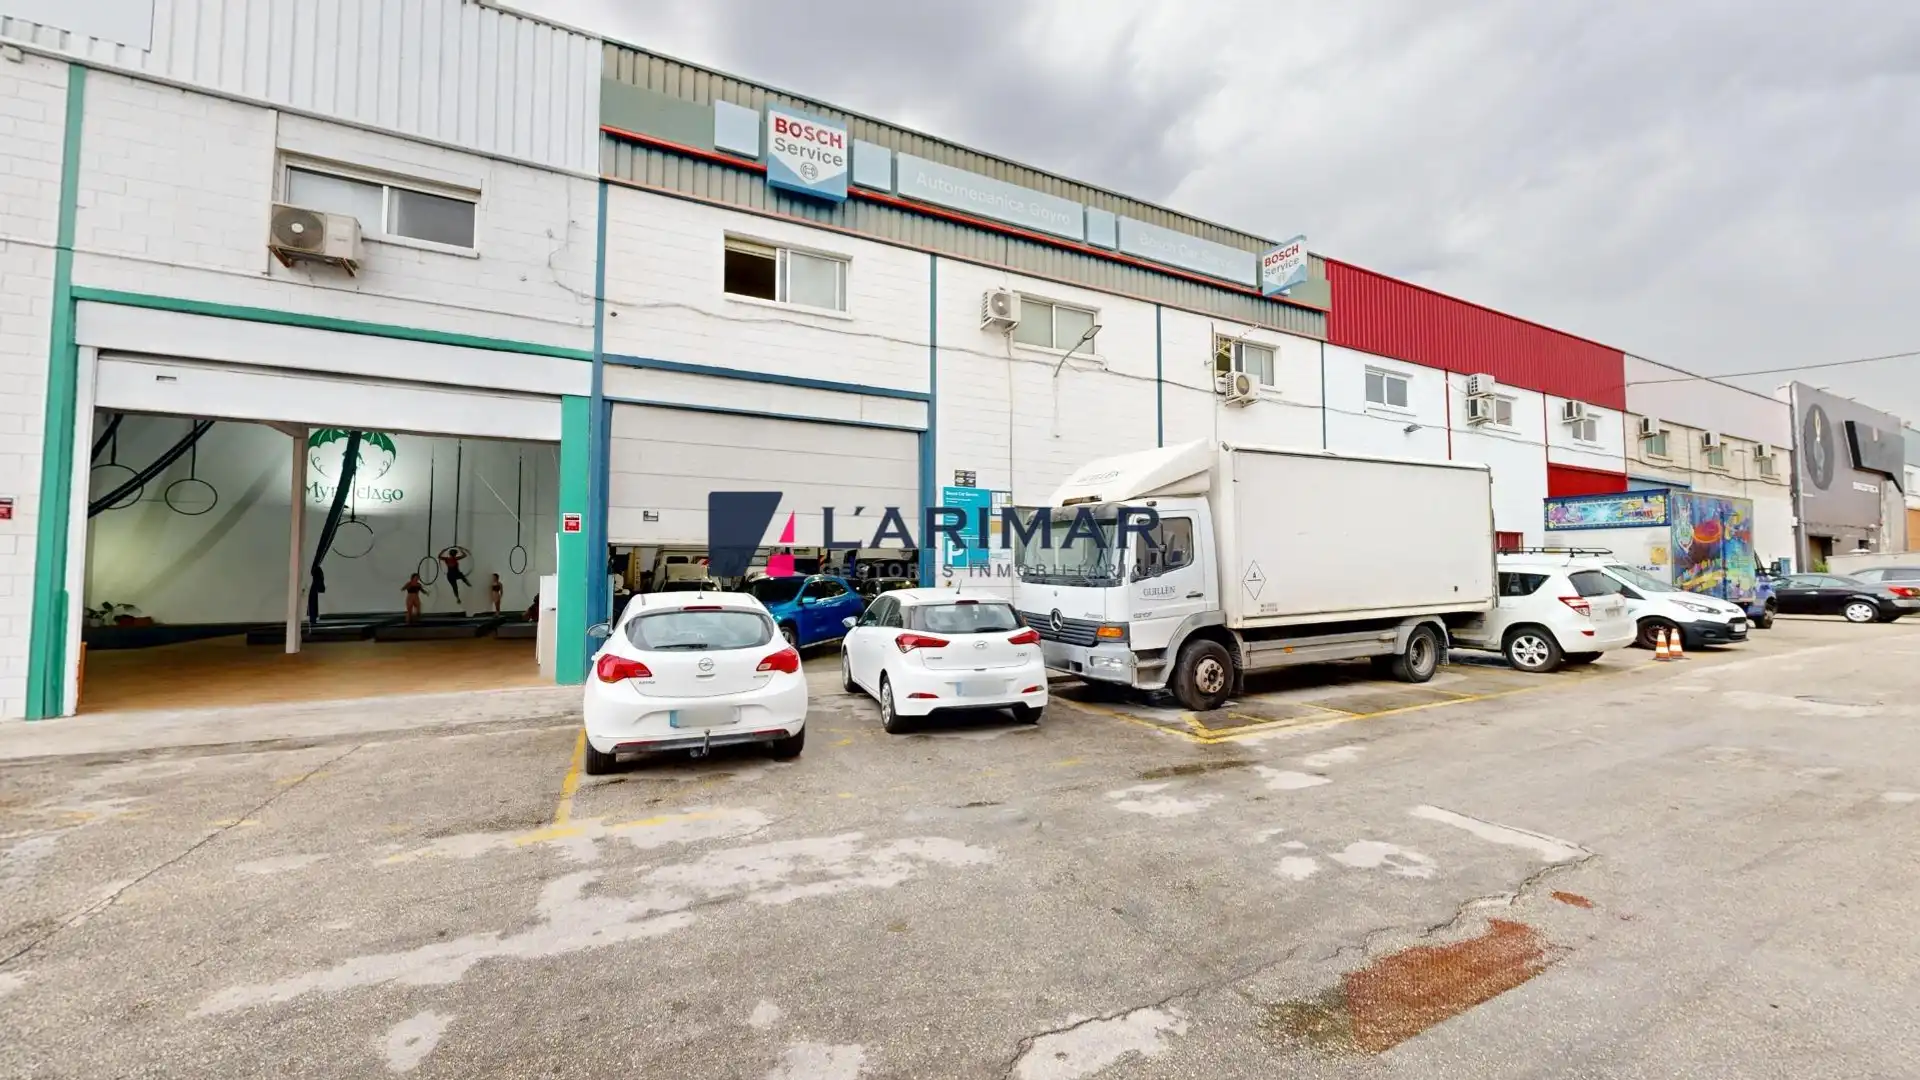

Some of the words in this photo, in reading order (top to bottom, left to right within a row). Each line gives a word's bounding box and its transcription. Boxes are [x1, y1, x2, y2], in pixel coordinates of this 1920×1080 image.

[775, 116, 843, 149] BOSCH
[775, 137, 843, 167] Service
[1264, 244, 1299, 267] BOSCH
[1264, 258, 1299, 277] Service
